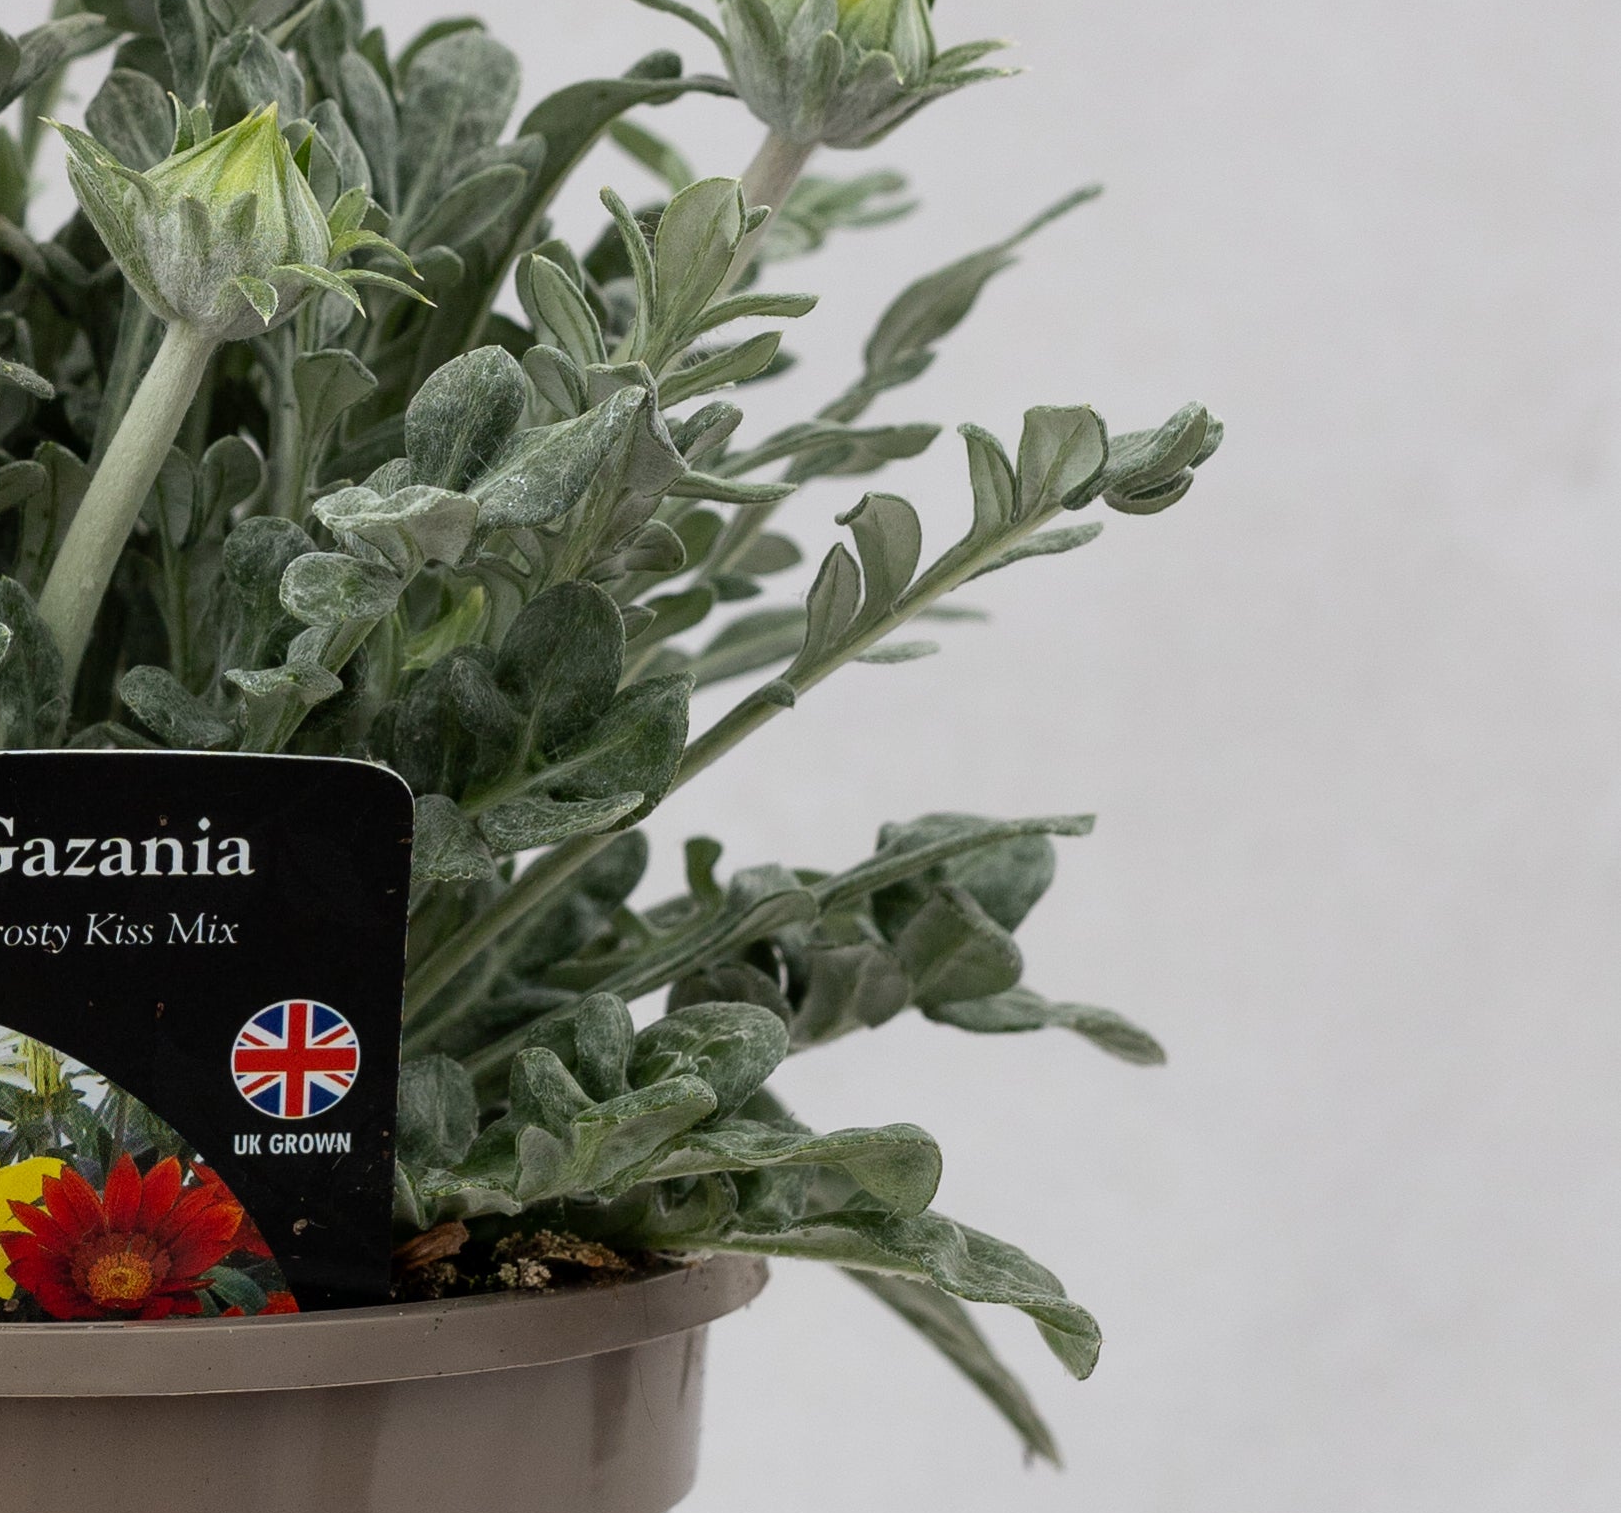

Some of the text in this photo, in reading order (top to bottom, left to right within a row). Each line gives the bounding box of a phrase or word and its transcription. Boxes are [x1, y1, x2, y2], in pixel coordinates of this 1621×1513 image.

[84, 912, 154, 946] Kiss
[167, 912, 239, 945] Mix
[234, 1132, 351, 1155] UK GROWN
